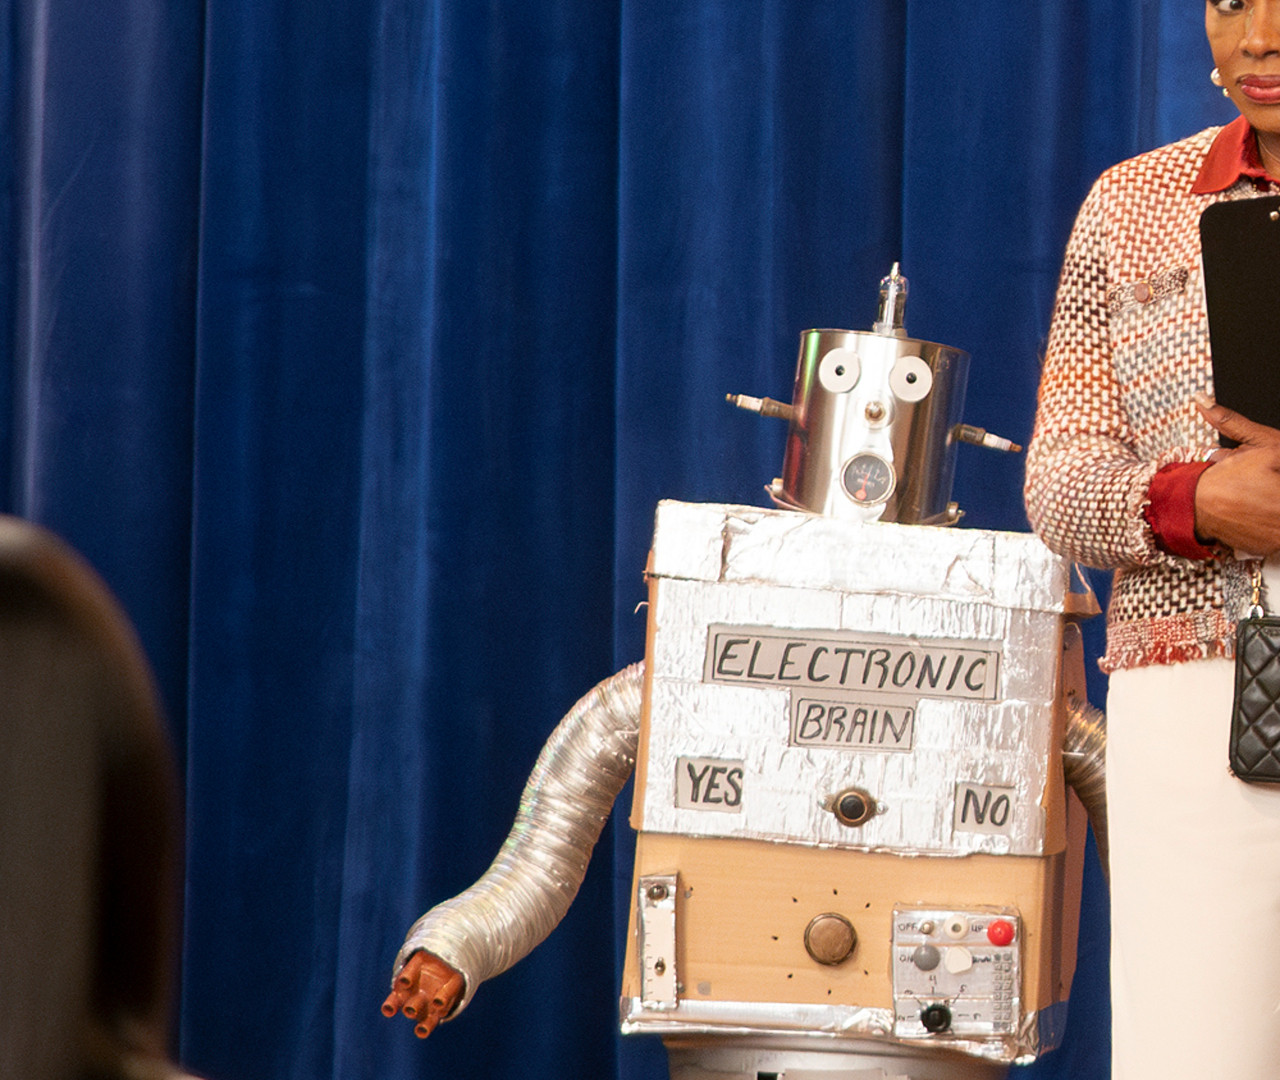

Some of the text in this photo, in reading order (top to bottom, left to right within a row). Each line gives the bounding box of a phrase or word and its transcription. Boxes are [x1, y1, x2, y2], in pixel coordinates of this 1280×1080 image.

[715, 638, 990, 691] ELECTRONIC
[799, 703, 911, 744] BRAIN
[686, 762, 743, 807] YES
[960, 787, 1010, 828] NO
[897, 922, 917, 932] OFF
